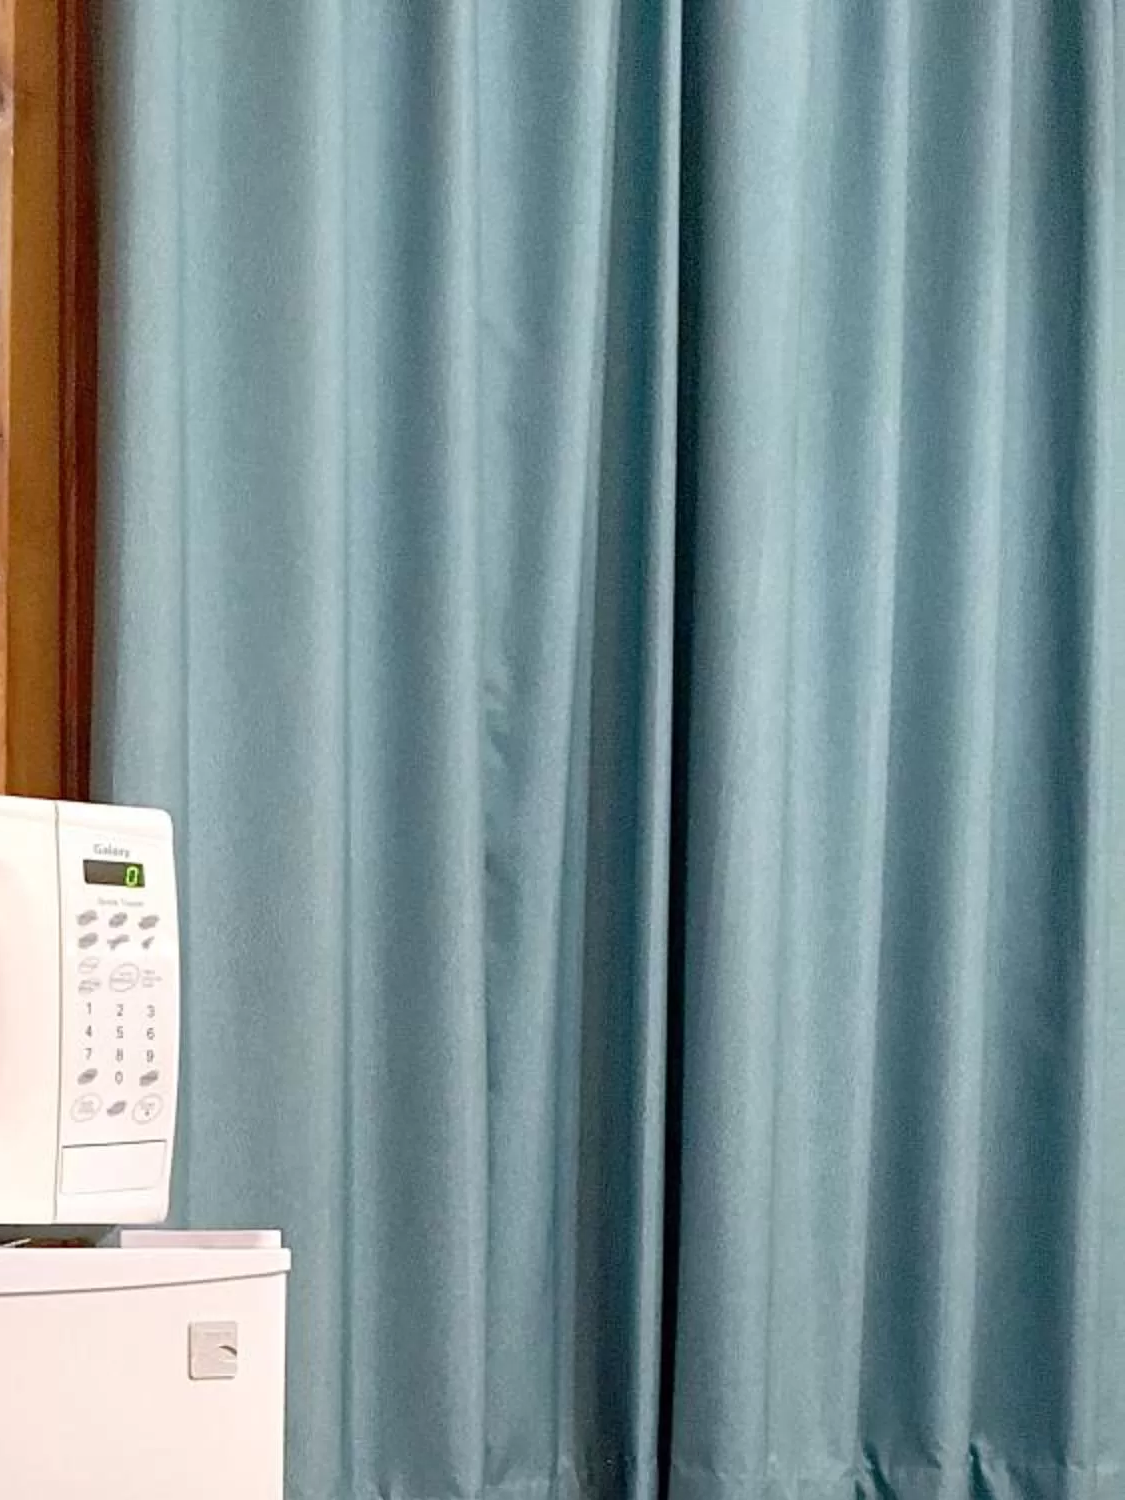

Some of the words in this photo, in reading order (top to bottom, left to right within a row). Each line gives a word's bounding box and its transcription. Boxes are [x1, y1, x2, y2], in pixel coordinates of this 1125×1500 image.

[85, 1001, 92, 1015] 1
[115, 1003, 124, 1017] 2
[146, 1004, 156, 1018] 3
[85, 1025, 93, 1038] 4
[115, 1025, 124, 1039] 5
[146, 1027, 155, 1041] 6
[84, 1047, 92, 1060] 7
[115, 1048, 124, 1063] 8
[146, 1049, 155, 1063] 9
[114, 1070, 124, 1085] 0
